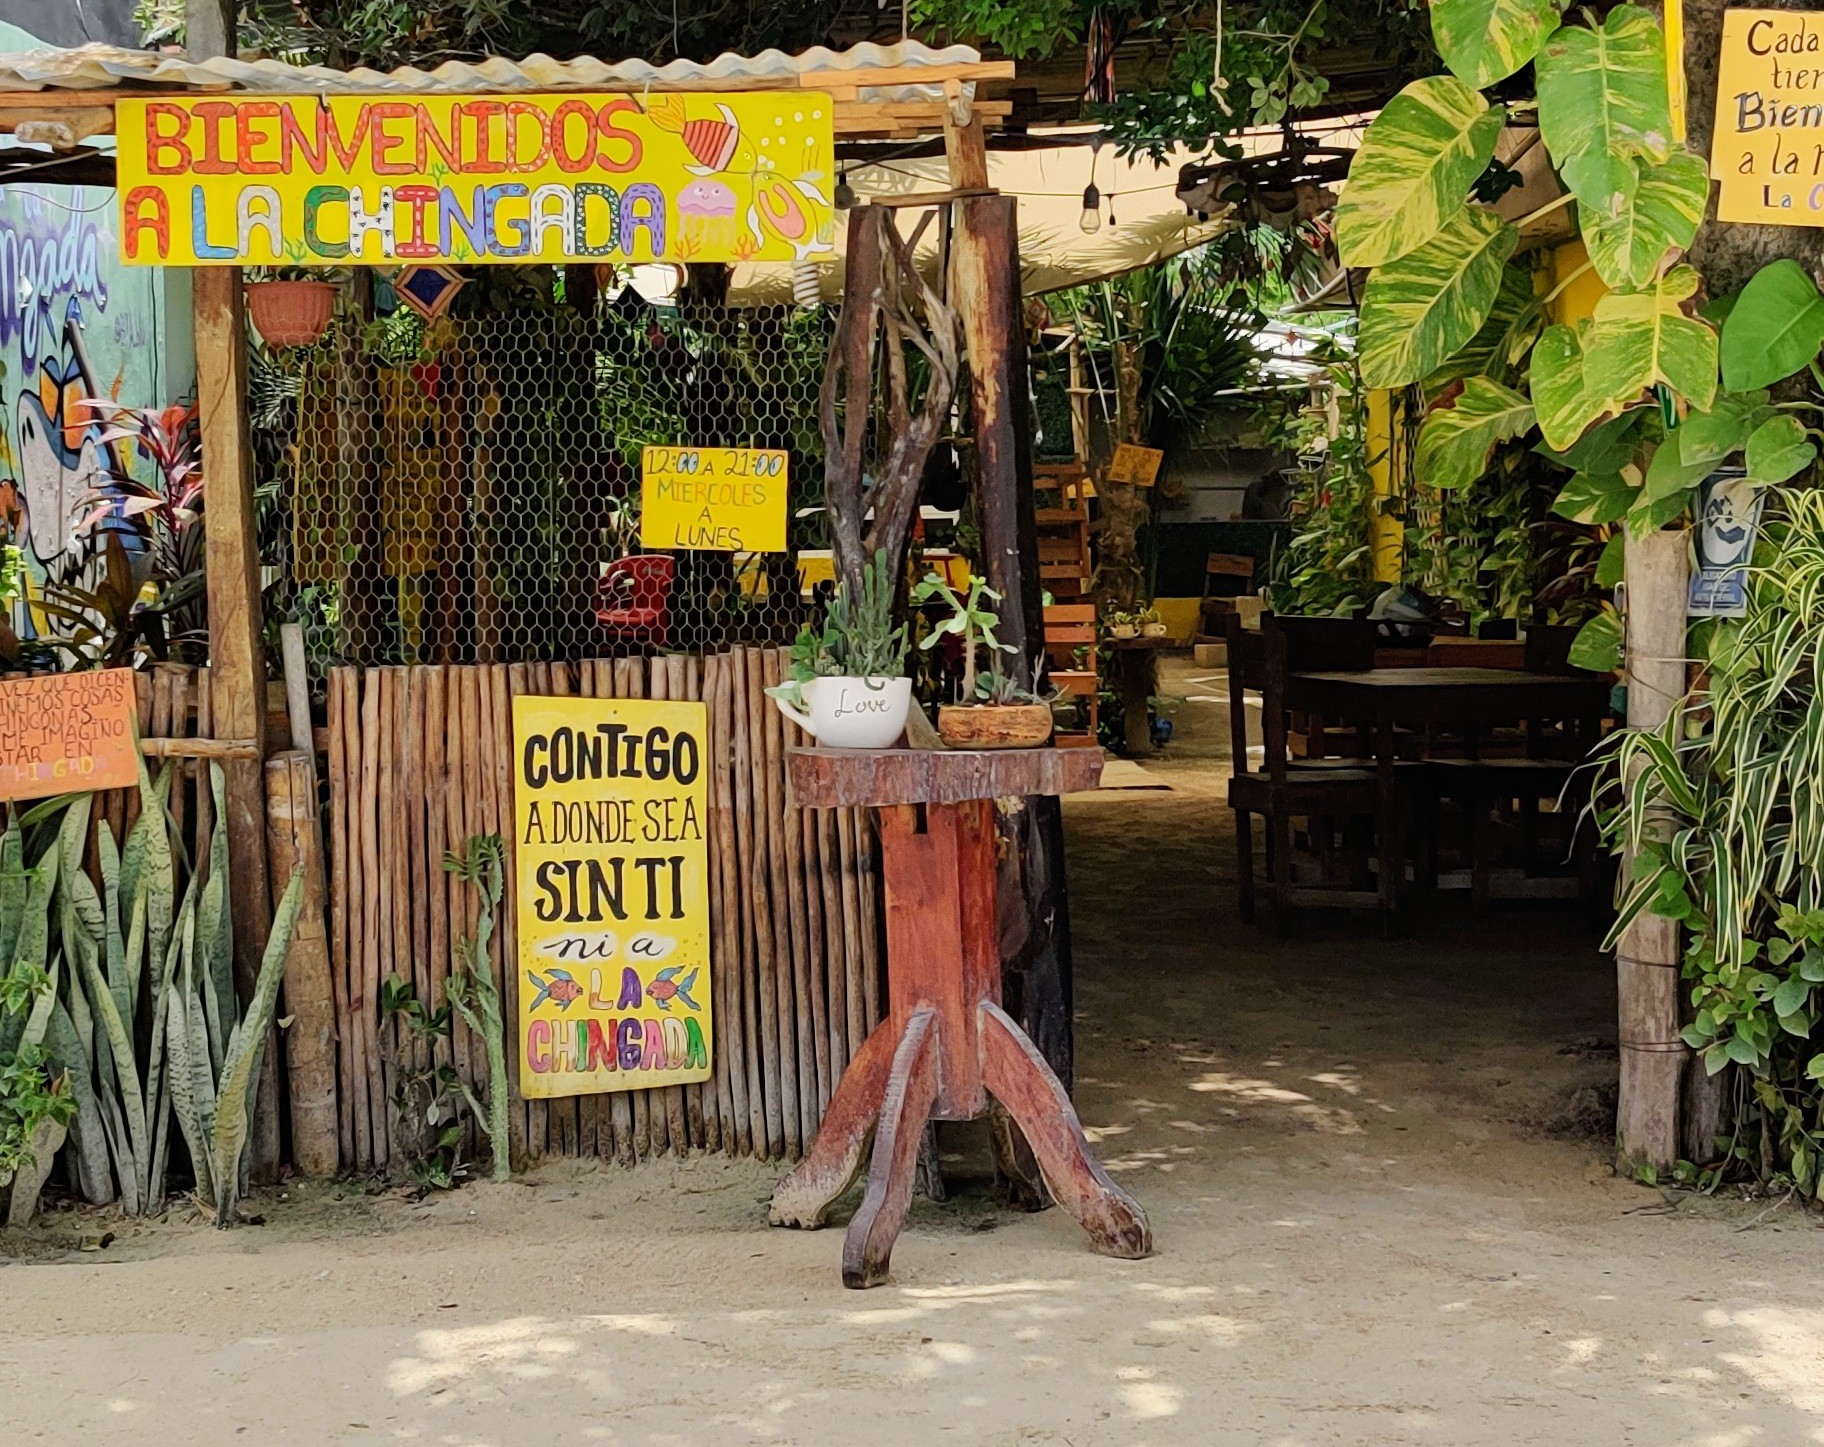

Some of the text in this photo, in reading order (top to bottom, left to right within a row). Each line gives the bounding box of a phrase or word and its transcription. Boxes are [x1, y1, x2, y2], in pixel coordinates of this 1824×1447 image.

[1746, 16, 1819, 56] Cada
[146, 99, 644, 176] BIENVENIDOS
[1738, 151, 1755, 175] a
[1771, 132, 1800, 175] la
[1763, 184, 1792, 209] La
[123, 184, 170, 259] A
[191, 184, 283, 260] LA
[303, 182, 666, 259] CHINGADA
[645, 448, 785, 478] 12:00 A 21:00
[657, 477, 767, 507] MIERCOLES
[698, 505, 712, 524] A
[674, 522, 744, 552] LUNES
[1, 679, 35, 698] VEZ
[41, 674, 76, 693] QUE
[70, 684, 124, 708] COSAS
[834, 688, 892, 718] Love
[2, 729, 29, 752] ME
[64, 738, 94, 759] EN
[523, 723, 699, 789] CONTIGO
[523, 795, 703, 845] A DONDE SEA
[533, 855, 686, 923] SIN TI
[543, 933, 665, 960] ni a
[588, 966, 643, 1012] LA
[527, 1016, 708, 1074] CHINGADA
